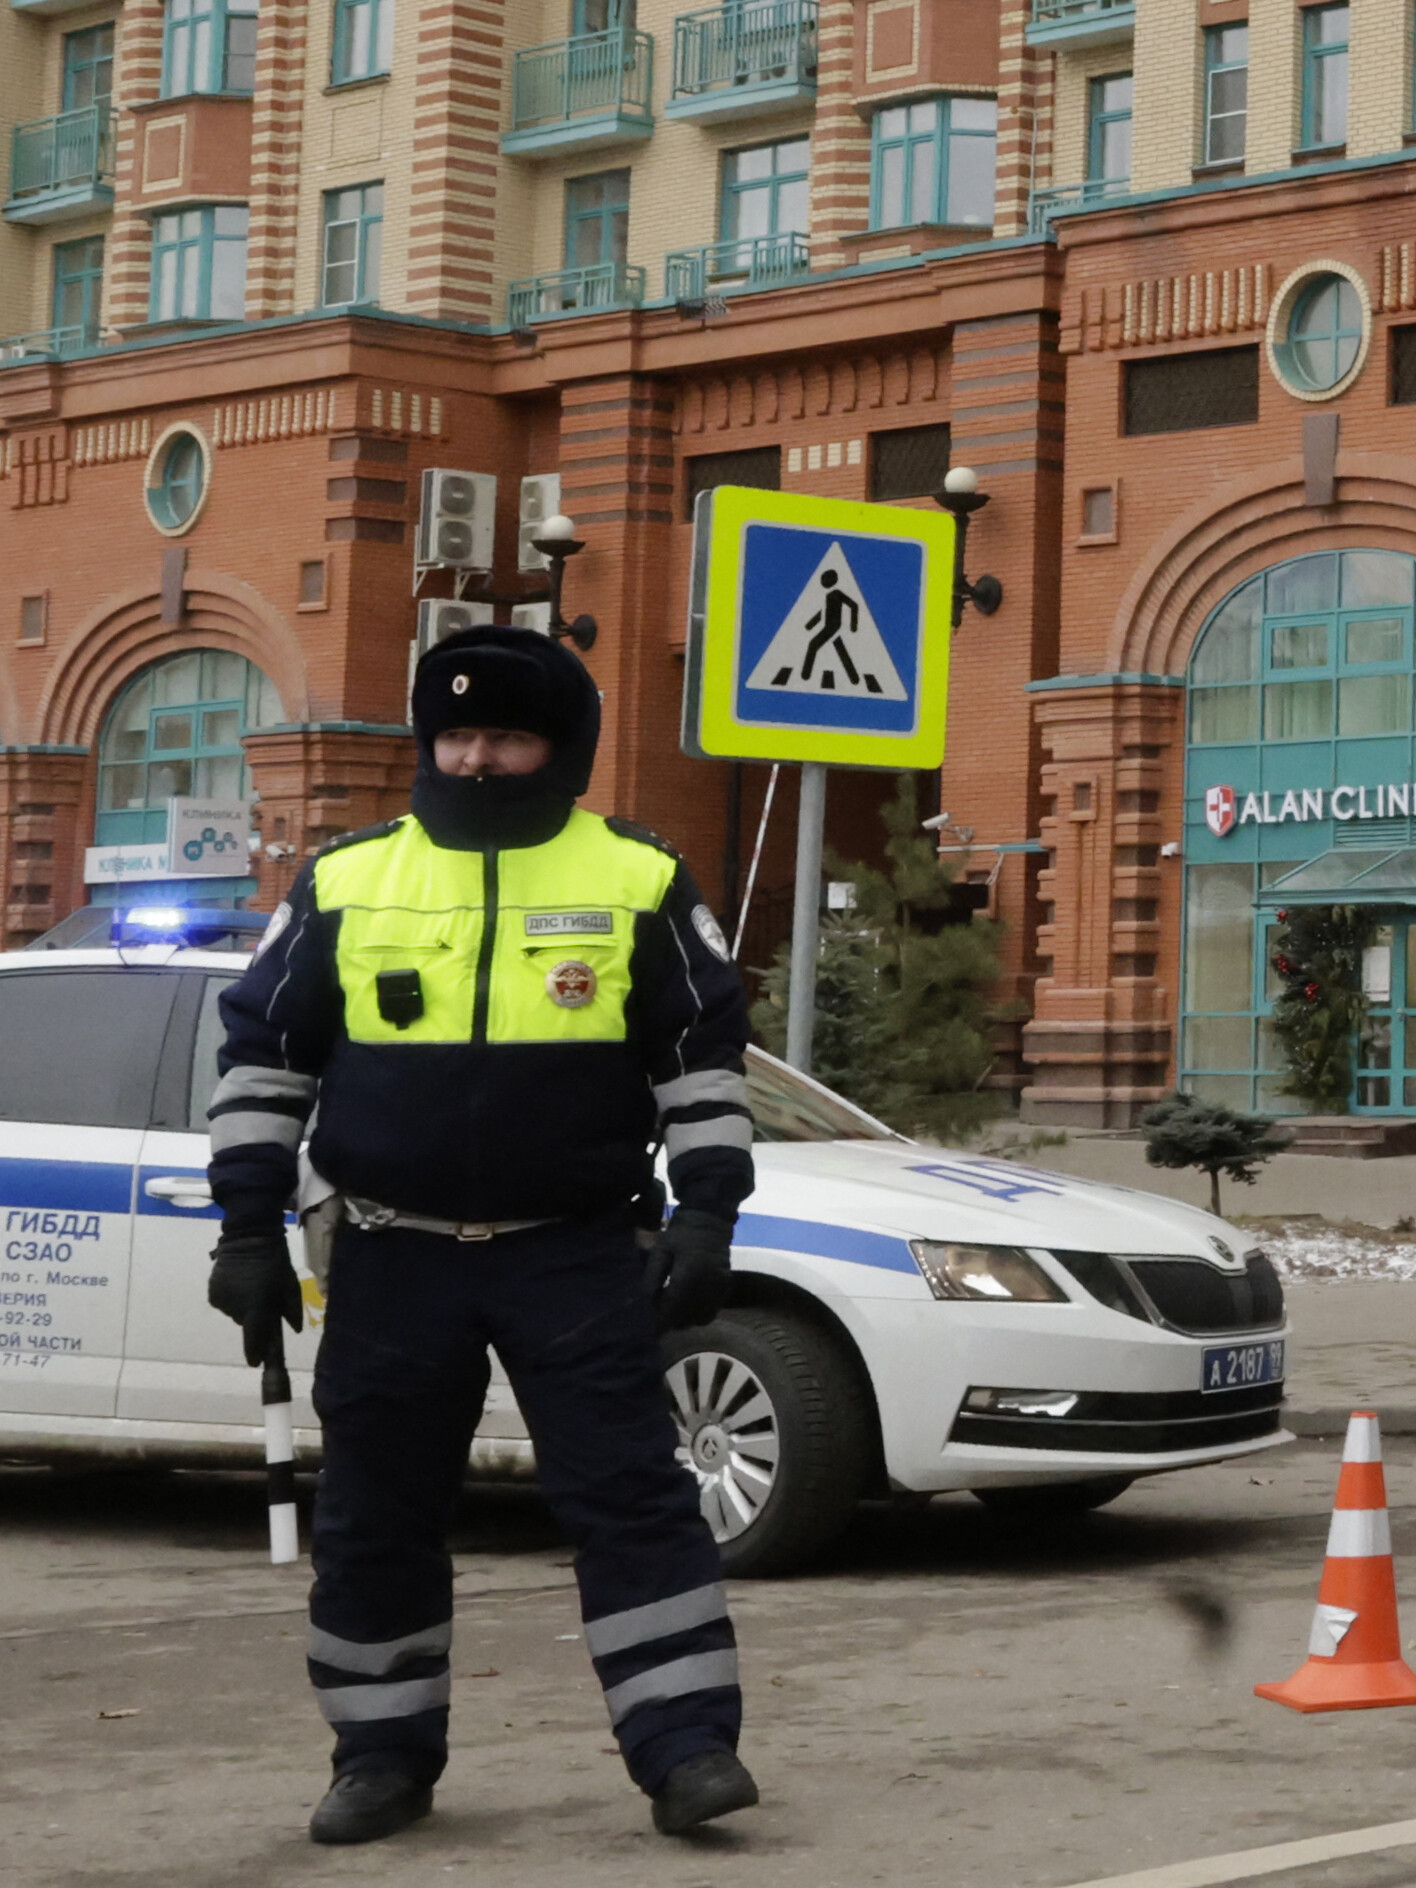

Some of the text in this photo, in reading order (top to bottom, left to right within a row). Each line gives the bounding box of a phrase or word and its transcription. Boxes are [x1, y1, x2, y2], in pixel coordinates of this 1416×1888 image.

[1239, 787, 1323, 824] ALAN
[529, 915, 609, 930] ДПС ГИБДД
[6, 1210, 101, 1241] ГИБДД
[6, 1240, 73, 1263] СЗАО
[46, 1271, 109, 1287] Москве
[27, 1335, 82, 1351] ЧАСТИ
[1210, 1360, 1221, 1387] А
[1227, 1347, 1264, 1384] 2187
